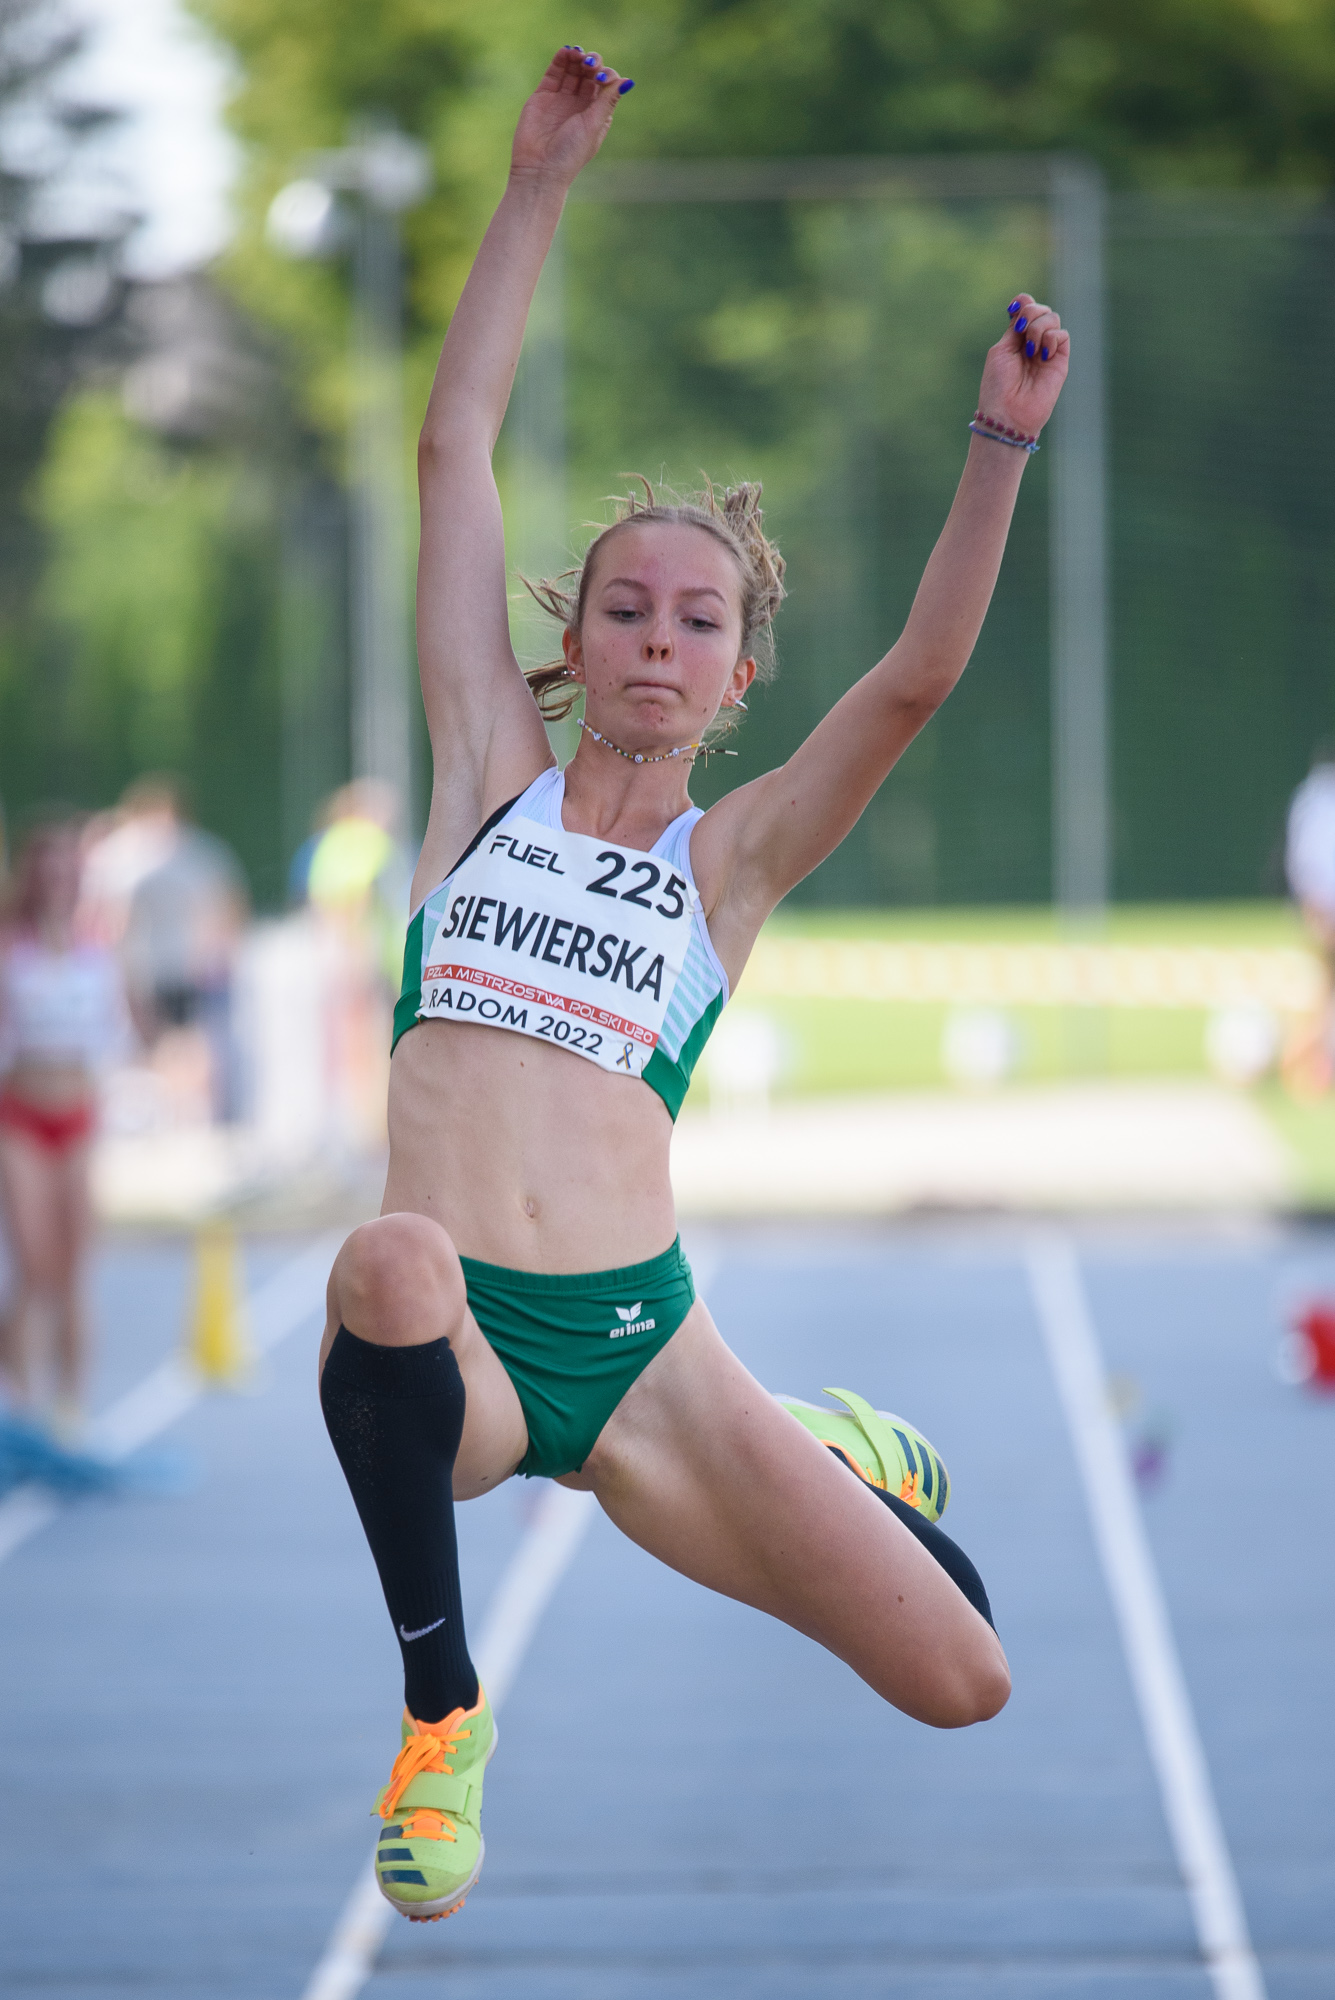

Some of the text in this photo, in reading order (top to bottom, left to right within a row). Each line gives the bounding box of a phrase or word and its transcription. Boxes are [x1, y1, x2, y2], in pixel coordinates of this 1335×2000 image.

[489, 834, 566, 875] FUEL
[586, 851, 688, 920] 225
[442, 896, 665, 1002] SIEWIERSKA
[428, 988, 604, 1055] RADOM 2022
[456, 968, 566, 1009] MISTRZOSTWA
[568, 1000, 622, 1030] POLSKI
[624, 1026, 654, 1044] U20
[609, 1318, 656, 1339] erima
